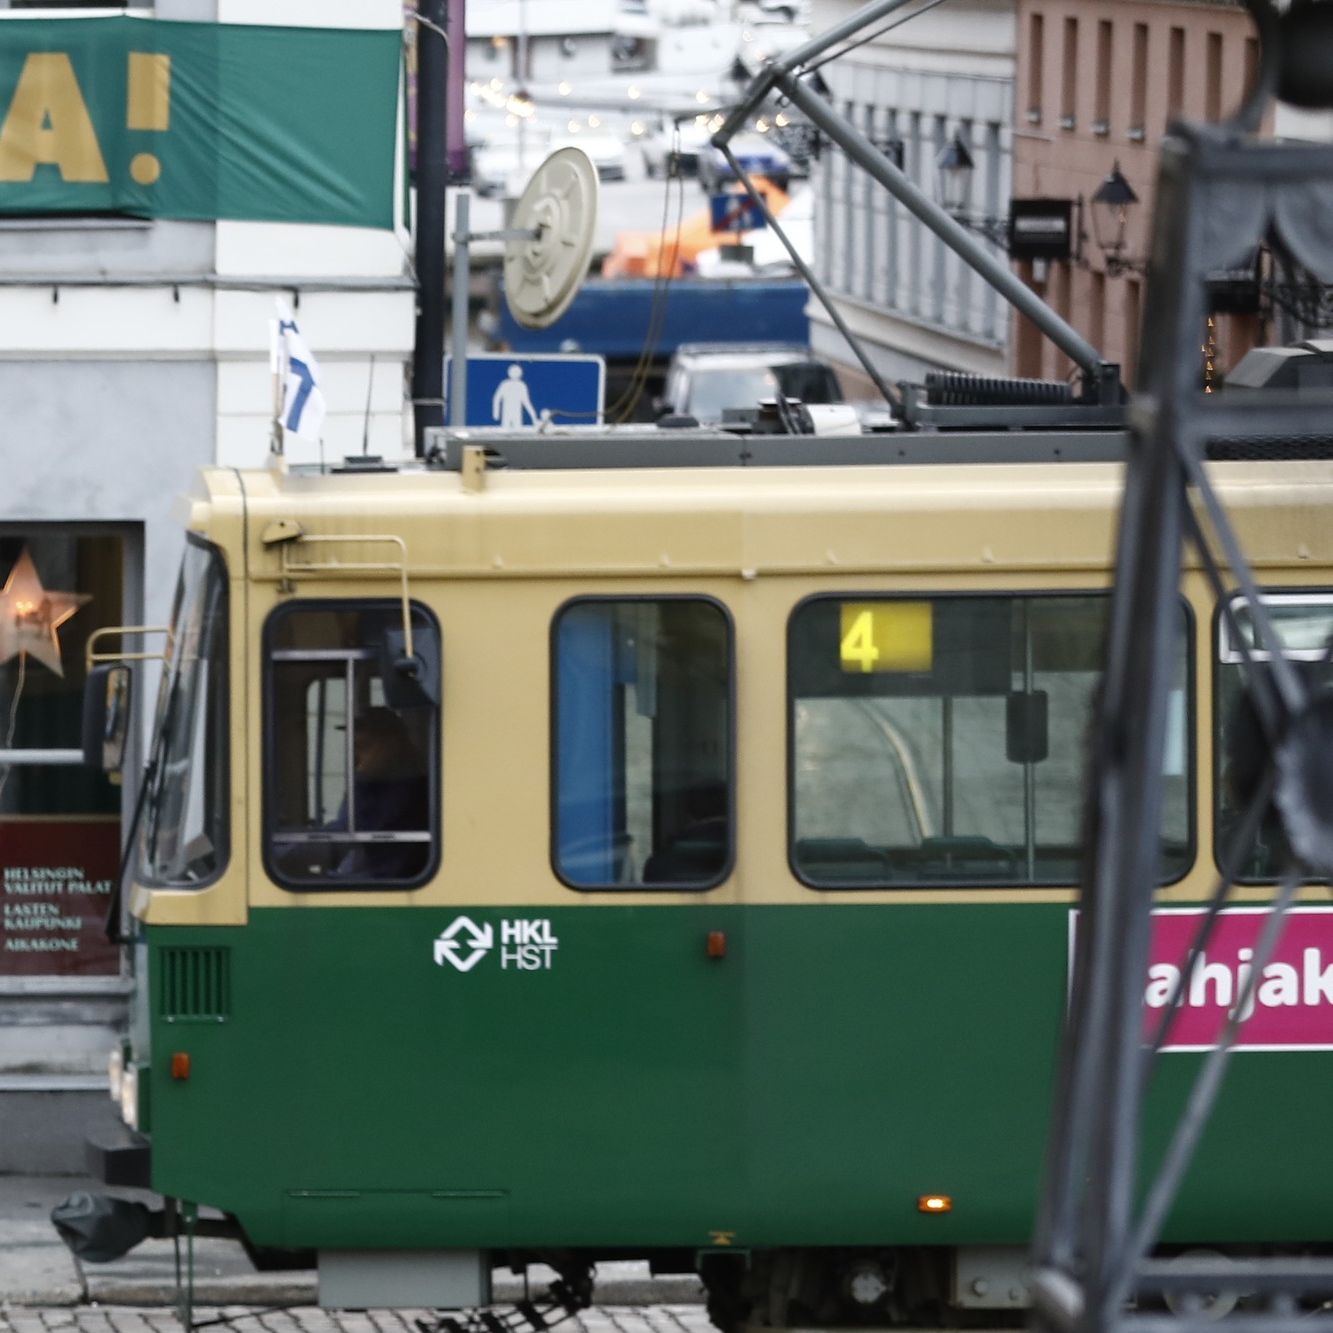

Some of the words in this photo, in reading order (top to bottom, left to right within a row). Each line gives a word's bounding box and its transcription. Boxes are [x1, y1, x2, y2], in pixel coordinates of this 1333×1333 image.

[840, 611, 879, 673] 4
[4, 866, 85, 880] HELSINGIN
[4, 880, 64, 895] VALITUT
[67, 880, 112, 895] PALAT
[4, 902, 60, 917] LASTEN
[4, 916, 82, 931] KAUPUNKI
[500, 919, 559, 945] HKL
[5, 937, 79, 952] AIKAKONE
[500, 944, 559, 971] HST
